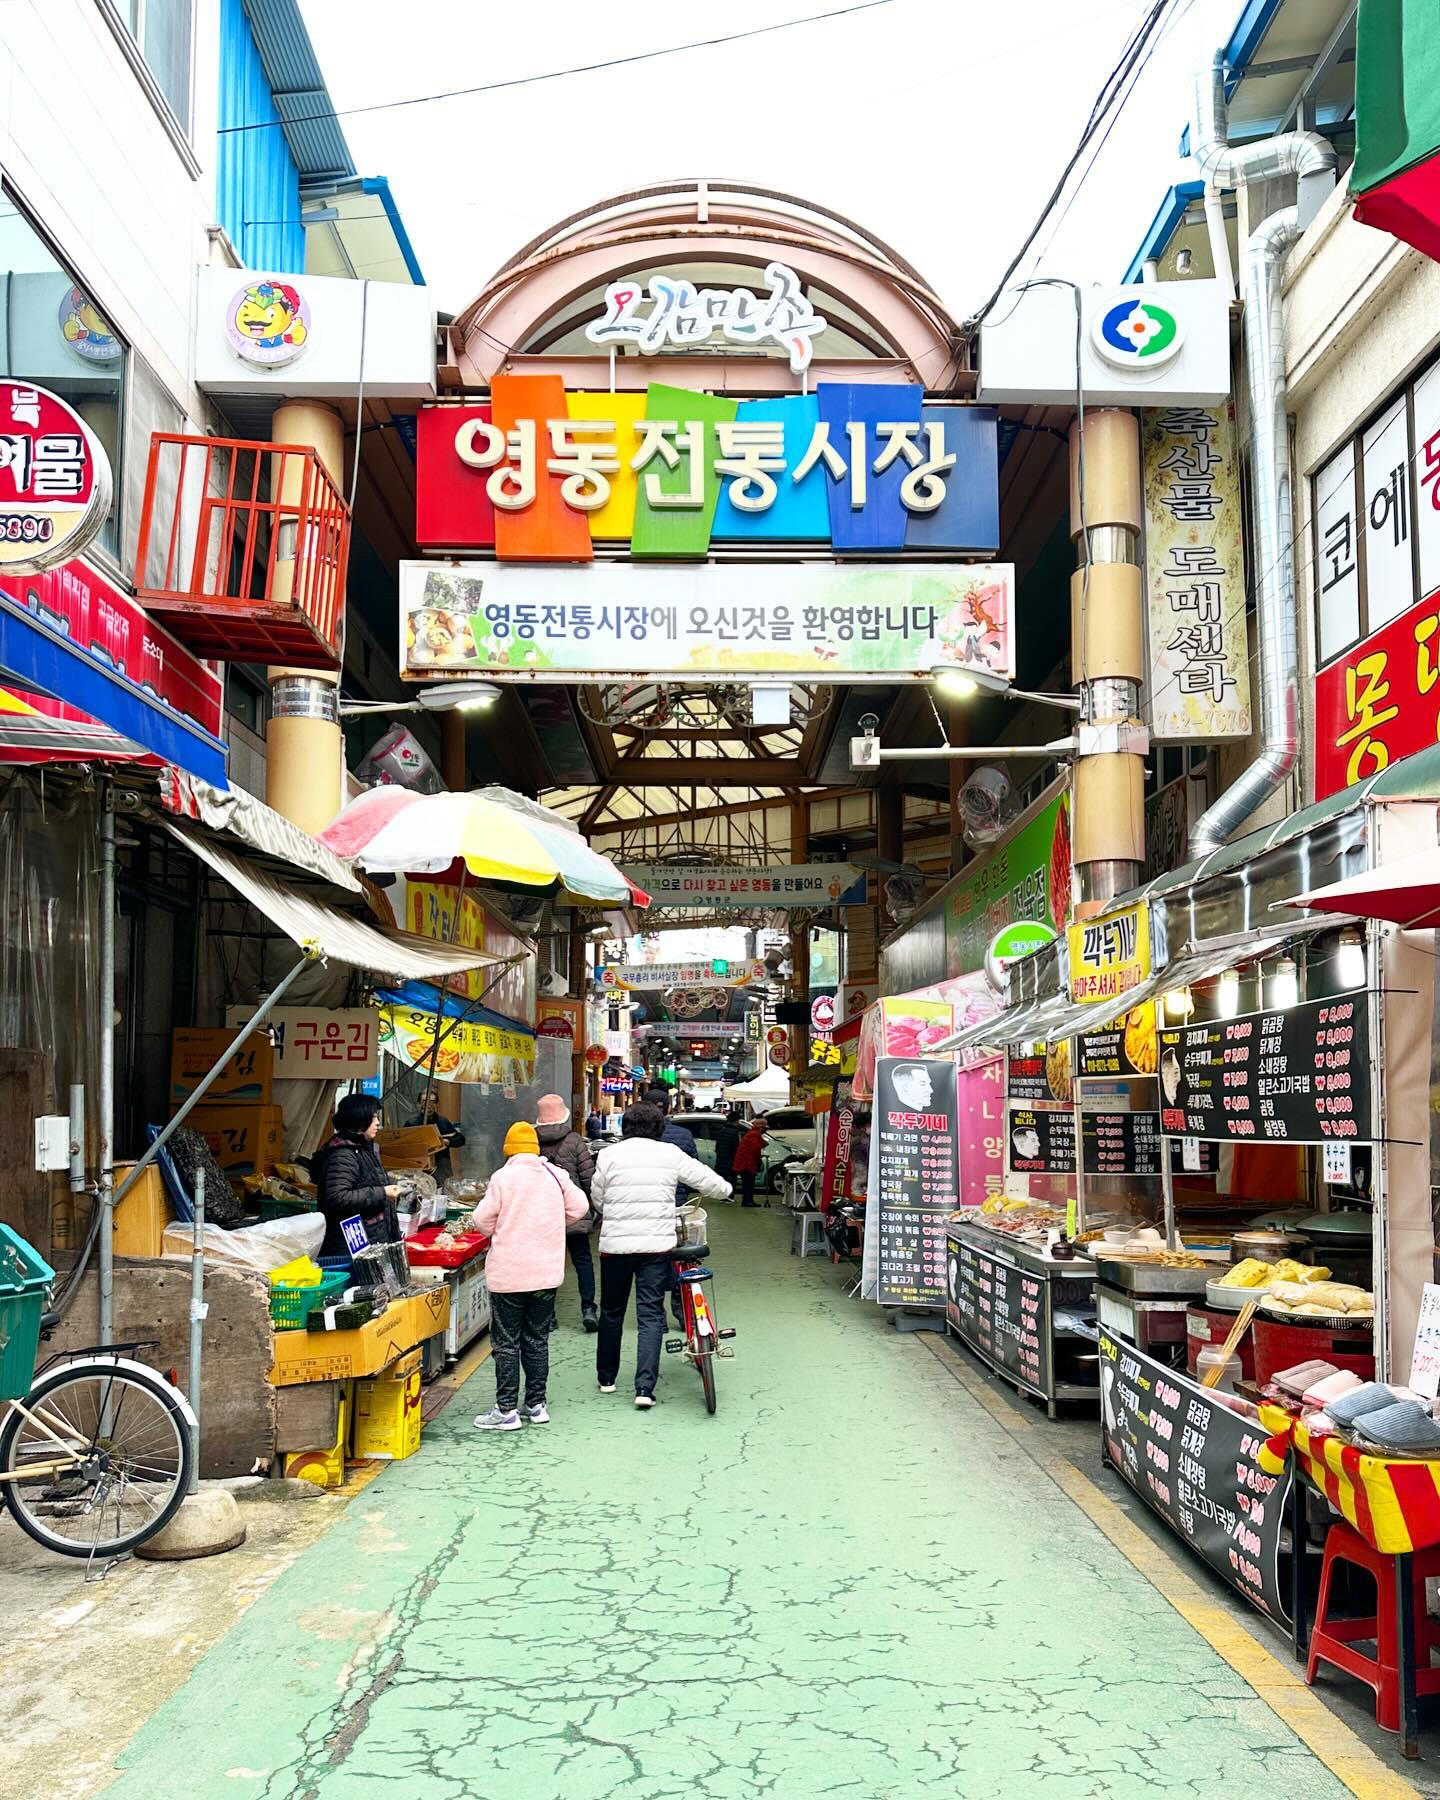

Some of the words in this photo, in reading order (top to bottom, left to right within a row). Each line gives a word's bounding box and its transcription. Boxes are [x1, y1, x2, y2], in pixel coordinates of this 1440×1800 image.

[592, 264, 820, 370] 오감만족
[455, 418, 957, 512] 영동전통시장
[484, 603, 678, 641] 영동전통시장에
[686, 605, 795, 641] 오신것을
[801, 604, 939, 642] 환영합니다
[784, 878, 824, 892] 만들어요
[295, 1022, 370, 1061] 구운김
[881, 1212, 902, 1221] 오징어
[881, 1224, 902, 1234] 오징어
